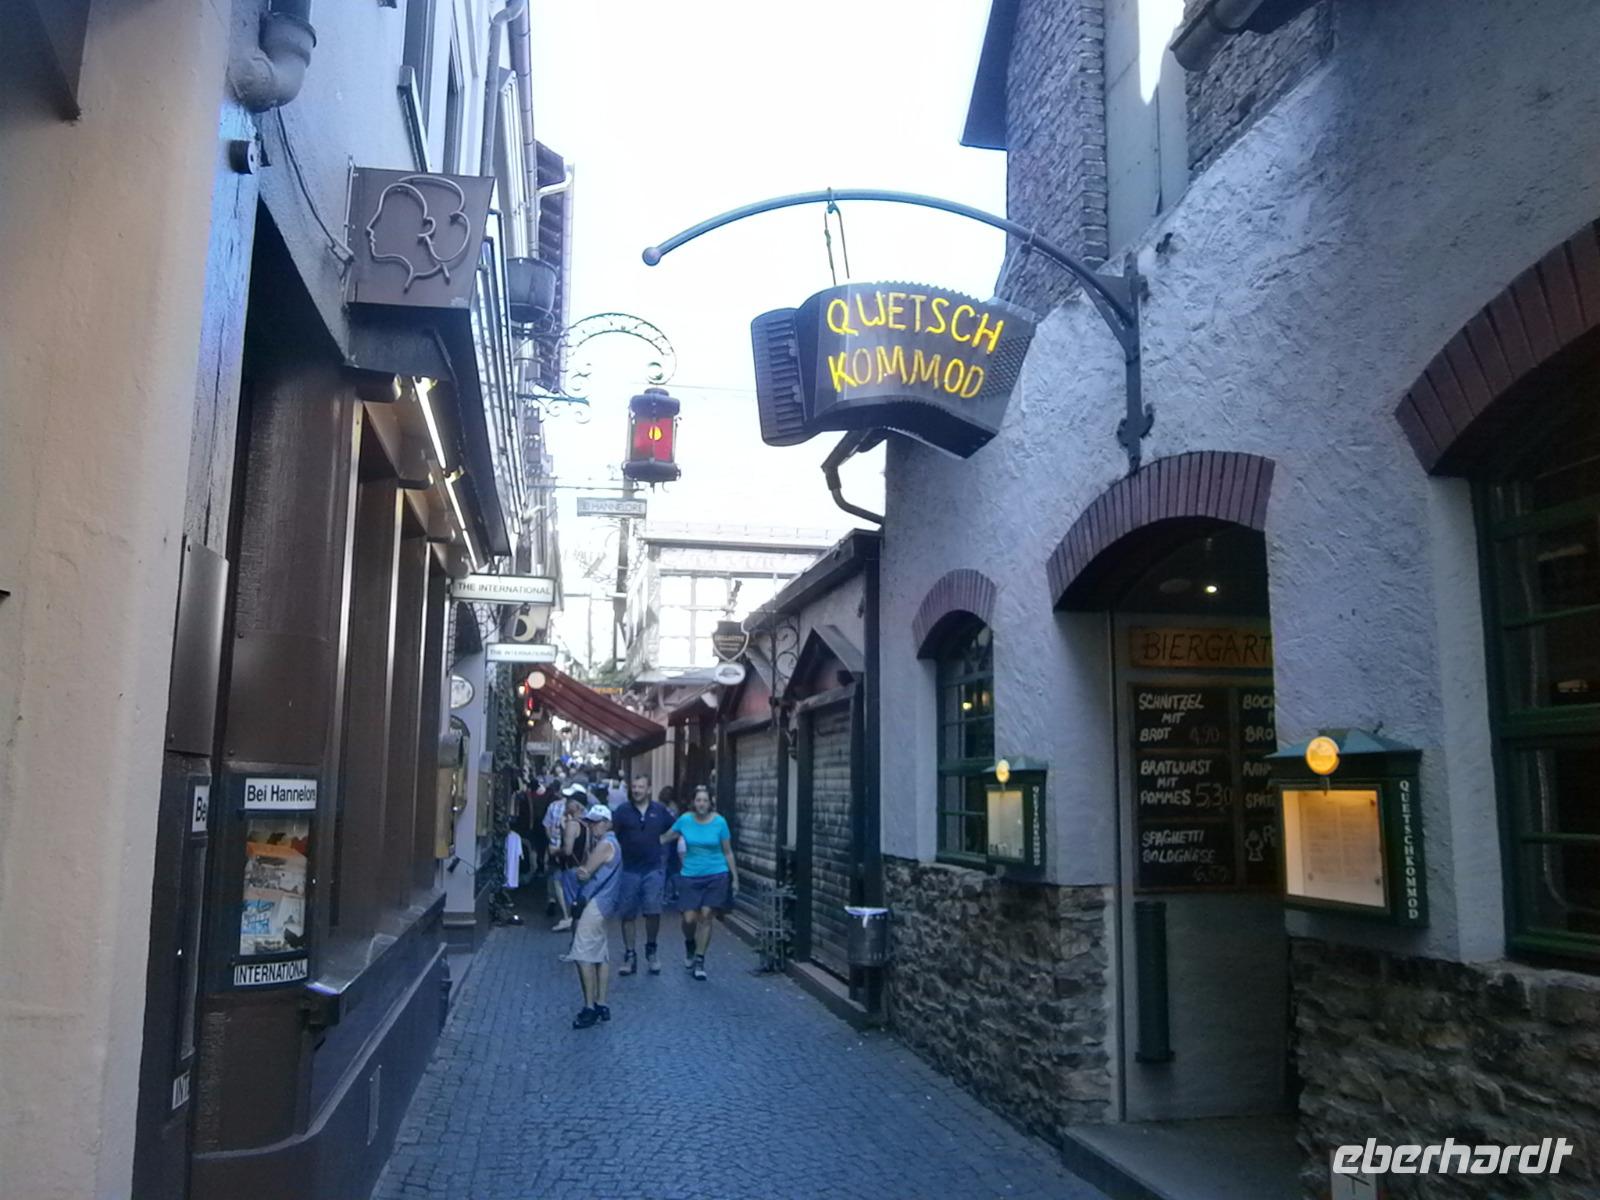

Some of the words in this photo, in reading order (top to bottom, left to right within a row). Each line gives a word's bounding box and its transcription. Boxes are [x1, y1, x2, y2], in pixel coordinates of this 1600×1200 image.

[827, 291, 1004, 355] QUETSCH
[828, 346, 985, 398] KOMMOD
[458, 582, 475, 592] THE
[478, 584, 551, 595] INTERNATIONAL
[1138, 692, 1205, 711] SCHNITZEL
[1161, 712, 1186, 725] MIT
[1139, 727, 1172, 742] BROT
[1140, 760, 1213, 776] BRATWURST
[1156, 777, 1179, 789] MIT
[248, 784, 267, 802] Bei
[1140, 789, 1191, 806] POMMES
[1141, 829, 1205, 847] SPAGHETTI
